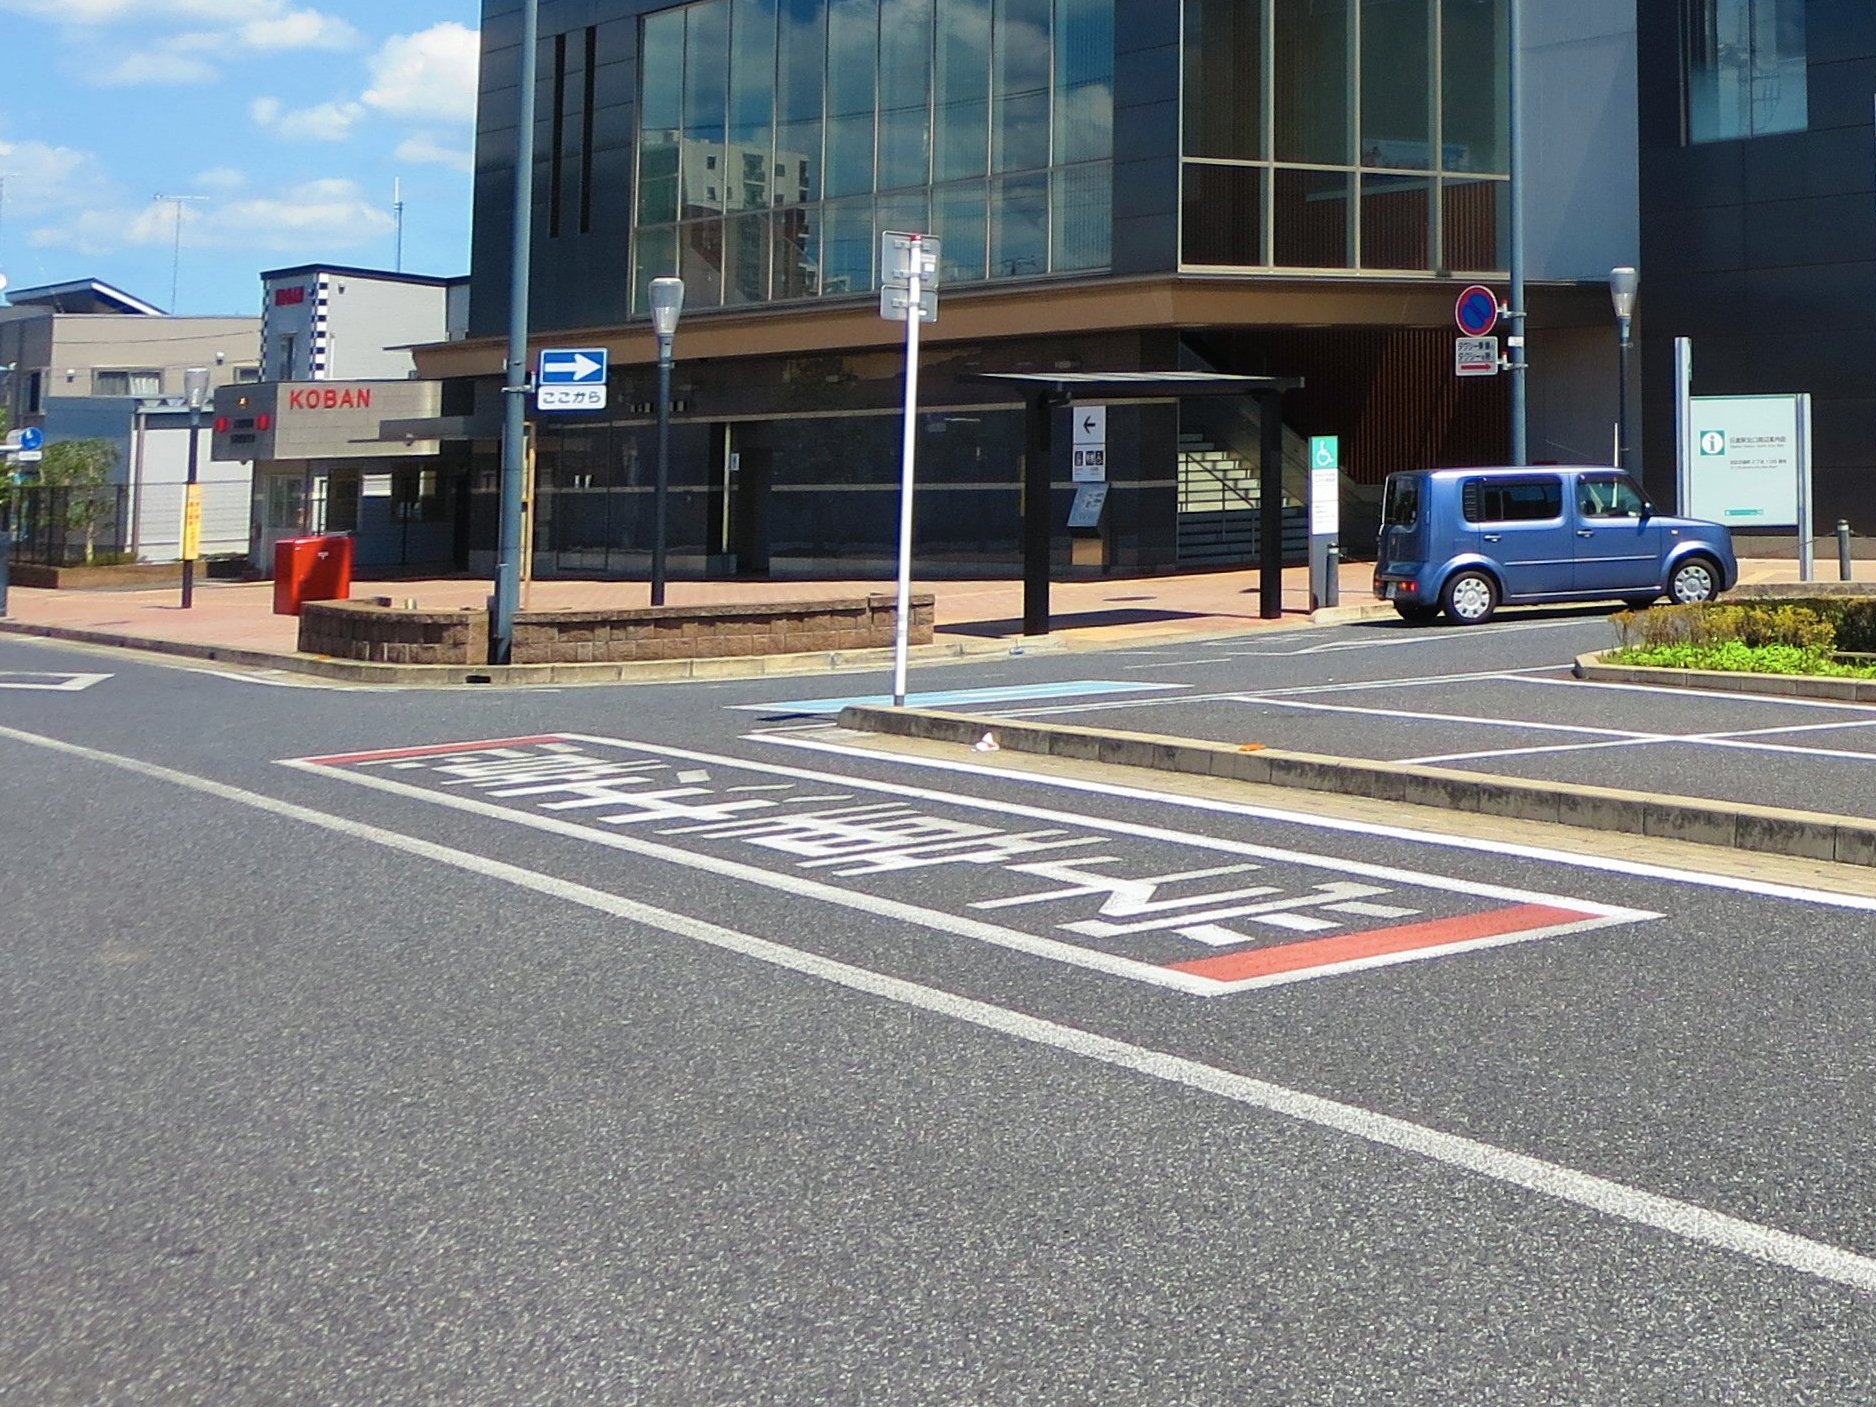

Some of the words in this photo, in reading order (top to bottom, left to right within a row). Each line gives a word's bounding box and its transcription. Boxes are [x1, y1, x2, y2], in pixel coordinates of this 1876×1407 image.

[289, 387, 371, 410] KOBAN
[542, 391, 602, 405] ここから
[385, 742, 1424, 946] 学童注意
